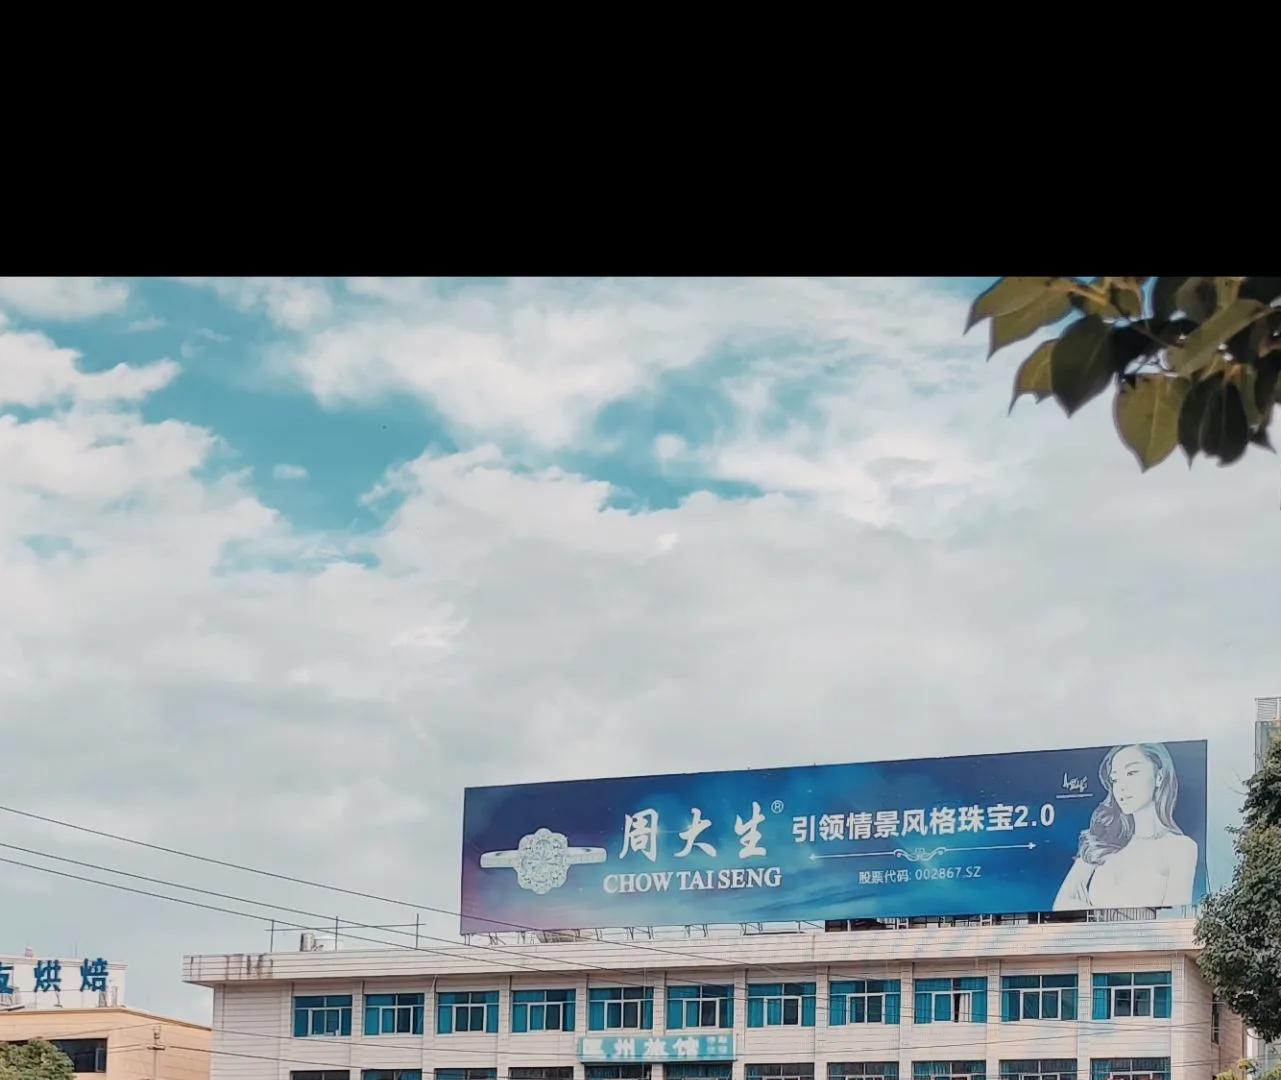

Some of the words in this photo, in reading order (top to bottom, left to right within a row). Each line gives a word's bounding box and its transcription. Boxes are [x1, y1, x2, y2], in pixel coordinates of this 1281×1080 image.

[619, 800, 768, 863] 周大生
[792, 803, 1056, 843] 引领情景风格珠宝2.0
[603, 871, 674, 894] CHOW
[679, 869, 715, 891] TAI
[717, 866, 783, 889] SENG
